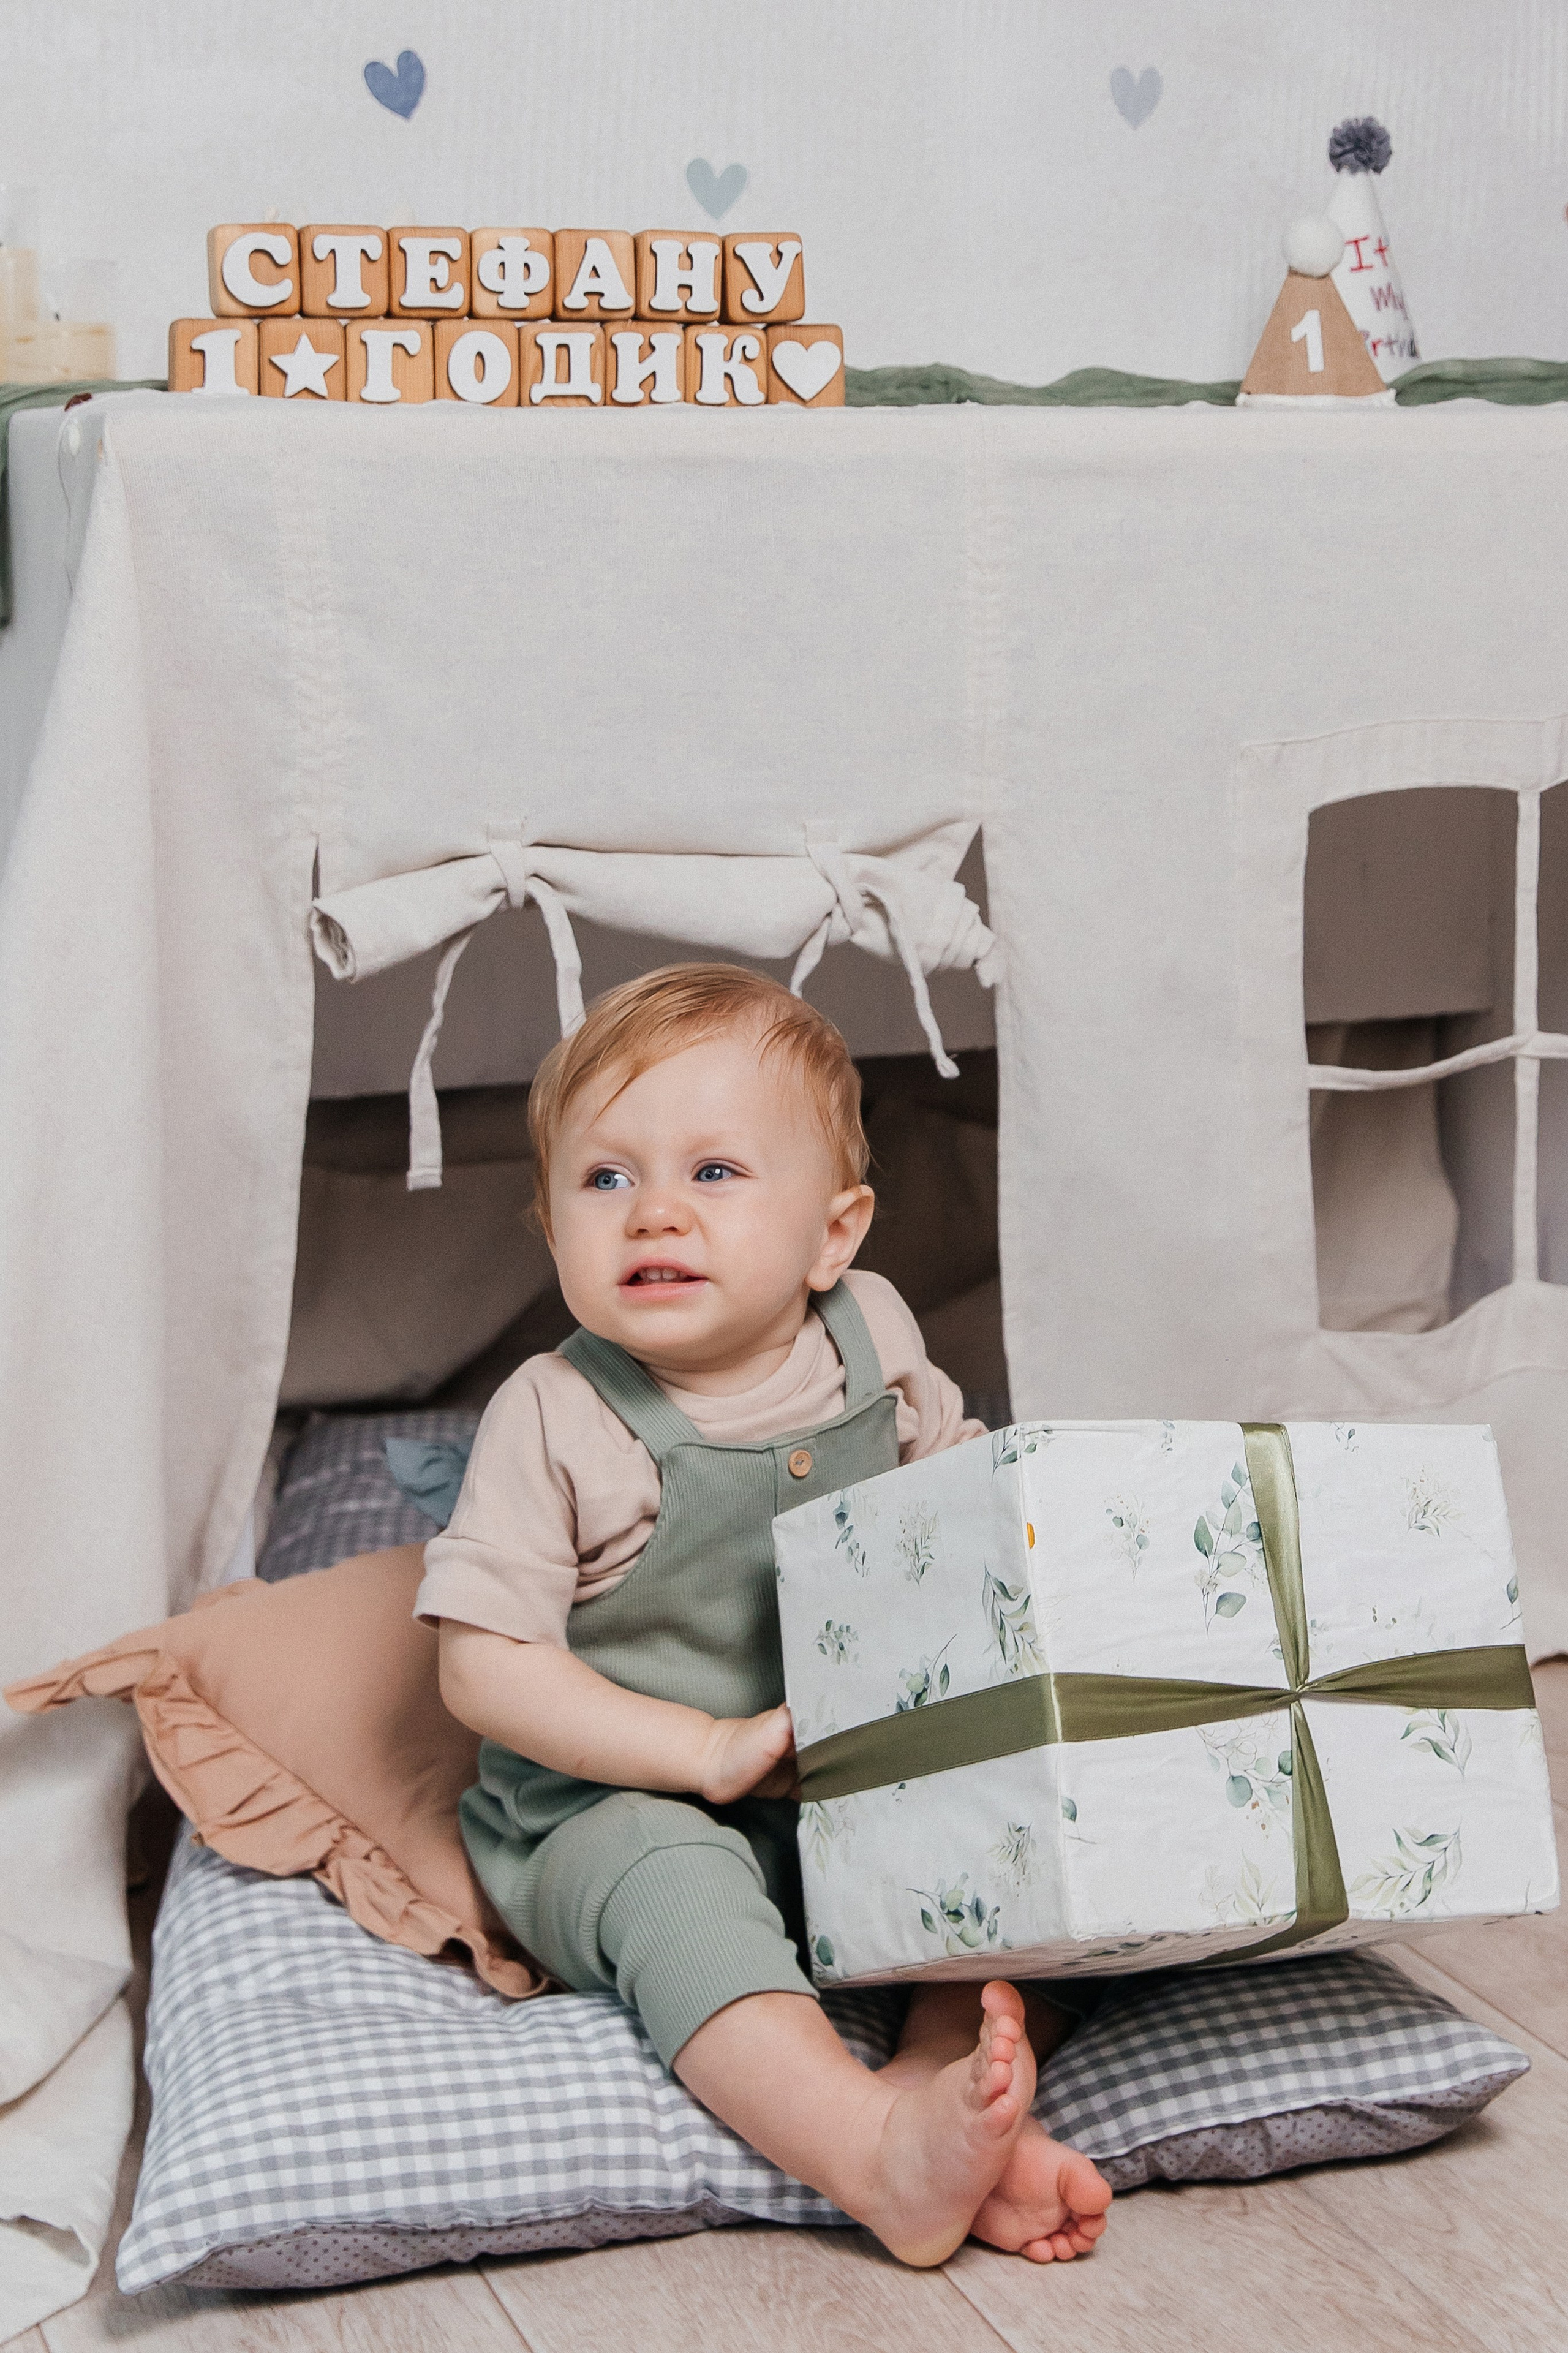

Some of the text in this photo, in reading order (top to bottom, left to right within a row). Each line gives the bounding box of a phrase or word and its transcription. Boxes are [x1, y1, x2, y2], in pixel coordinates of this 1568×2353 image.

[222, 232, 803, 314] СТЕФАНУ
[190, 328, 767, 406] 1 ГОДИК
[1291, 309, 1324, 372] 1
